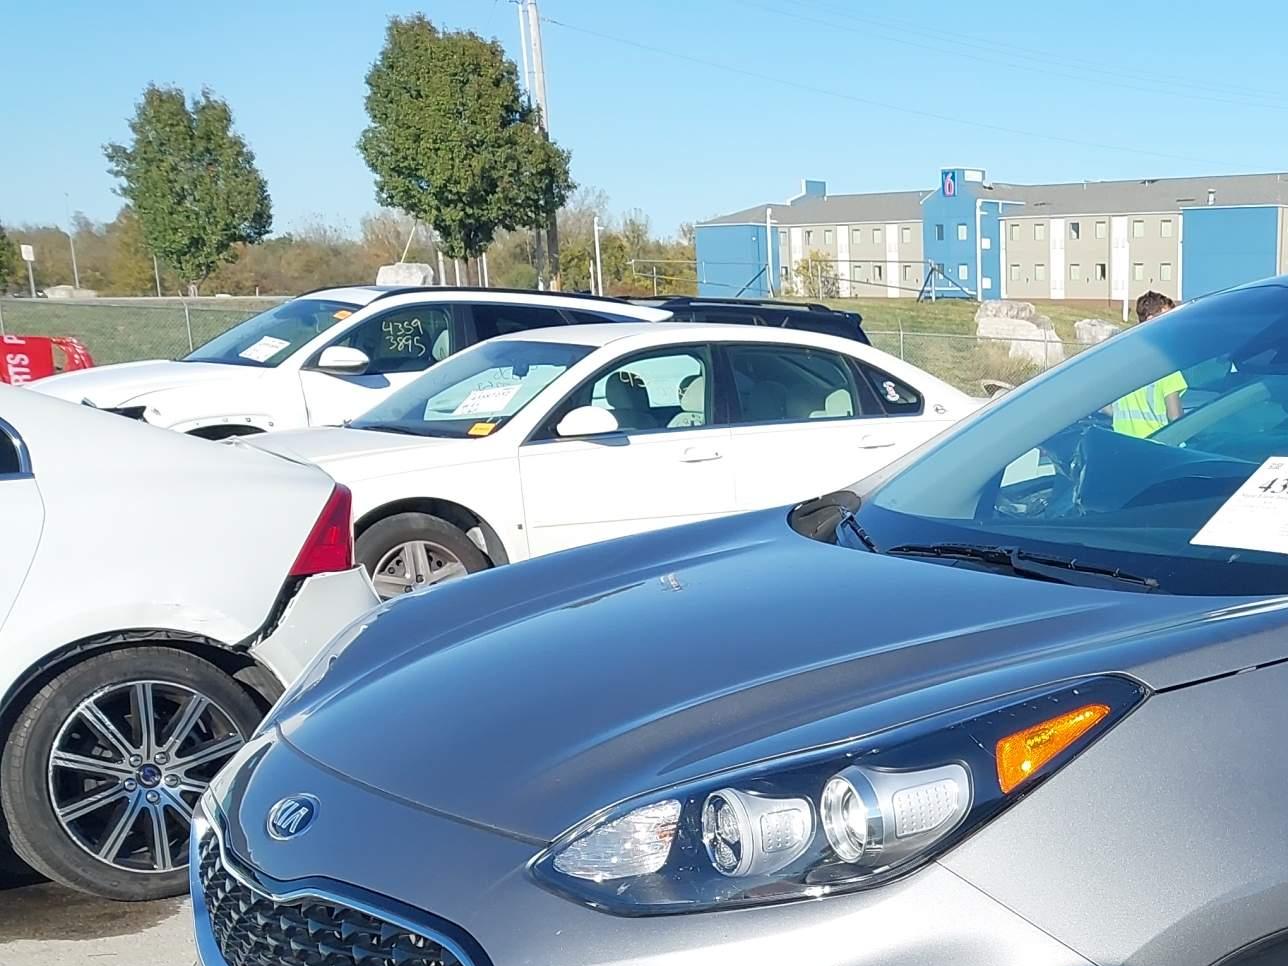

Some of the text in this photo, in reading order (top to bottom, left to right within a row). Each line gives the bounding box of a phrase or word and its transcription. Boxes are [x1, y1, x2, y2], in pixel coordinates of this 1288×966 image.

[944, 172, 954, 196] 6
[382, 318, 423, 335] 4359
[385, 335, 426, 357] 3895
[6, 353, 31, 385] RTS
